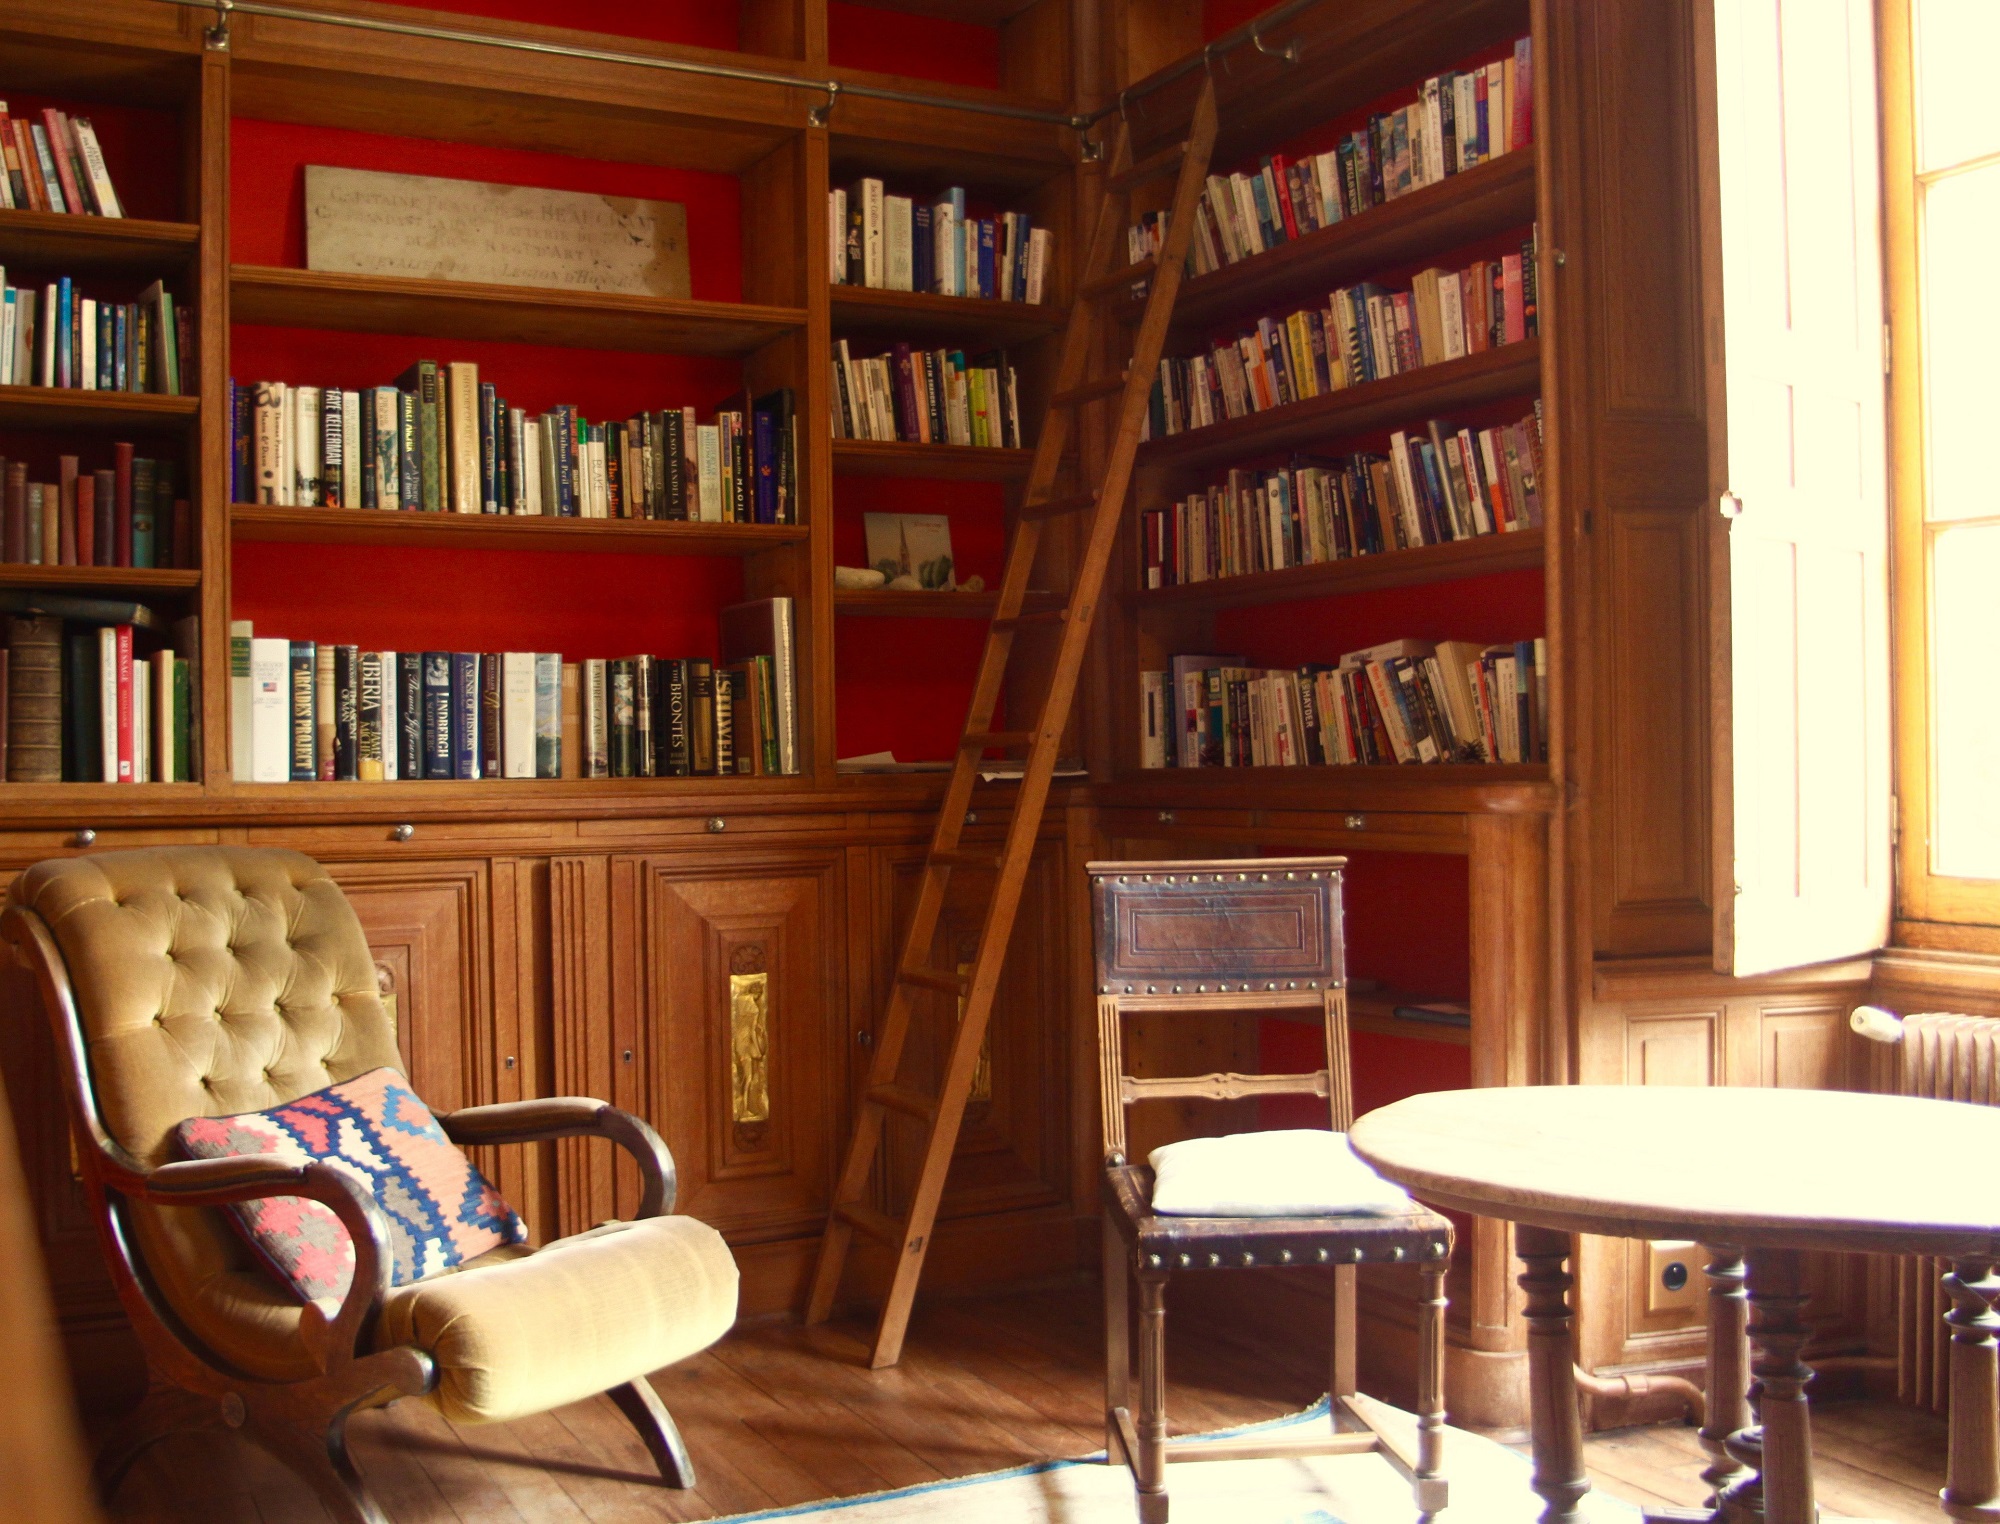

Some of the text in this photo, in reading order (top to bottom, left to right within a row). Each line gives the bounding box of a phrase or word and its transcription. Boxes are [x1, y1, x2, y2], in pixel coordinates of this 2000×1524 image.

[326, 390, 342, 465] FAYE KELLERMAN
[559, 410, 569, 485] Not Without Peril
[592, 459, 603, 492] BLAKE
[608, 461, 618, 480] The
[669, 421, 680, 505] NELSON MANDELA
[404, 483, 412, 500] Birth
[121, 635, 129, 683] DRESSAGE
[294, 669, 312, 717] ARCADES
[342, 688, 350, 722] OF MAN
[363, 661, 381, 710] IBERIA
[593, 665, 602, 702] EMPIRE
[350, 706, 358, 740] ASCENT
[404, 673, 421, 760] Thomas Jefferson
[426, 701, 434, 726] SCOTT
[436, 691, 450, 758] LINDBERGH
[465, 660, 475, 751] A SENSE OF HISTORY
[1302, 690, 1314, 728] HAYDER
[295, 719, 313, 769] PROJECT
[371, 731, 382, 761] JAMES
[426, 729, 435, 752] BERG
